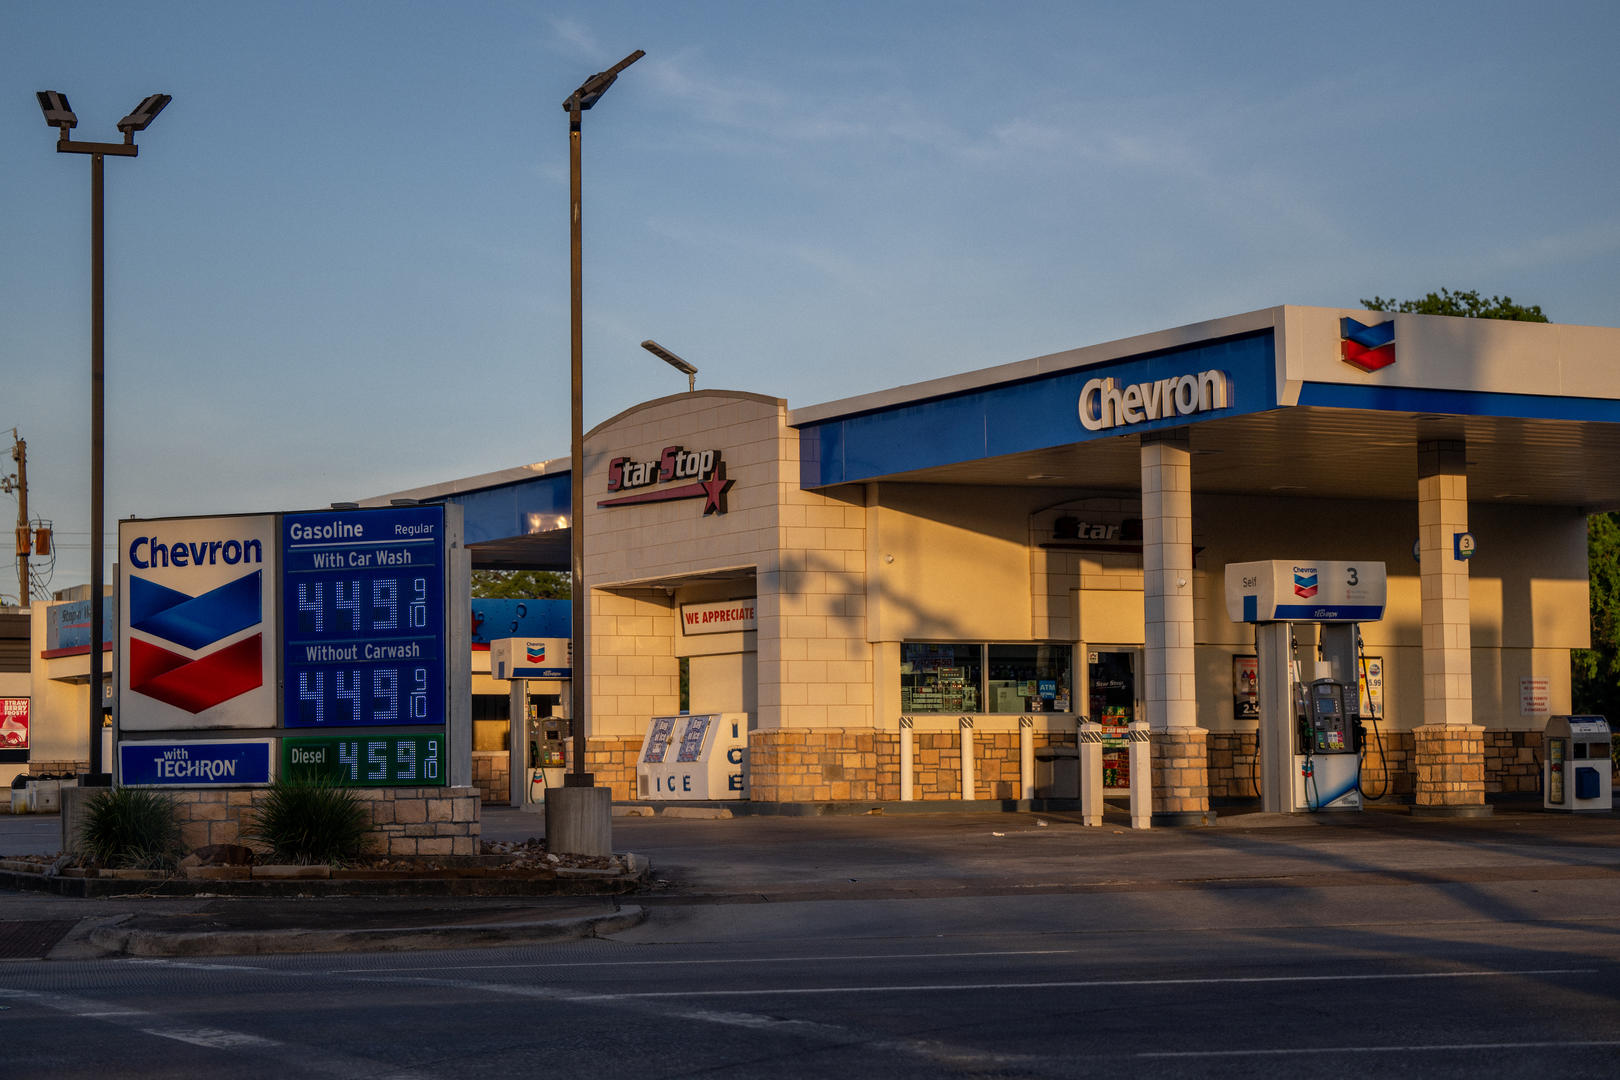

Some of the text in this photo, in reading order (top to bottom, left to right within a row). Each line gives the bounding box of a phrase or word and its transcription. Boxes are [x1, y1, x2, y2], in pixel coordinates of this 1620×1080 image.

[1079, 369, 1228, 431] Chevron
[608, 446, 715, 490] Star Stop
[290, 520, 364, 540] Gasoline
[394, 523, 434, 536] Regular
[129, 536, 263, 569] Chevron
[1464, 538, 1470, 548] 3
[313, 548, 412, 568] With Car Wash
[1242, 576, 1257, 588] Self
[1346, 567, 1359, 586] 3
[685, 607, 754, 625] WE APPRECIATE
[306, 641, 420, 662] Without Carwash
[163, 748, 189, 760] with
[291, 748, 326, 764] Diesel
[727, 718, 745, 792] ICE
[154, 758, 236, 781] TECHRON
[656, 775, 692, 792] ICE
